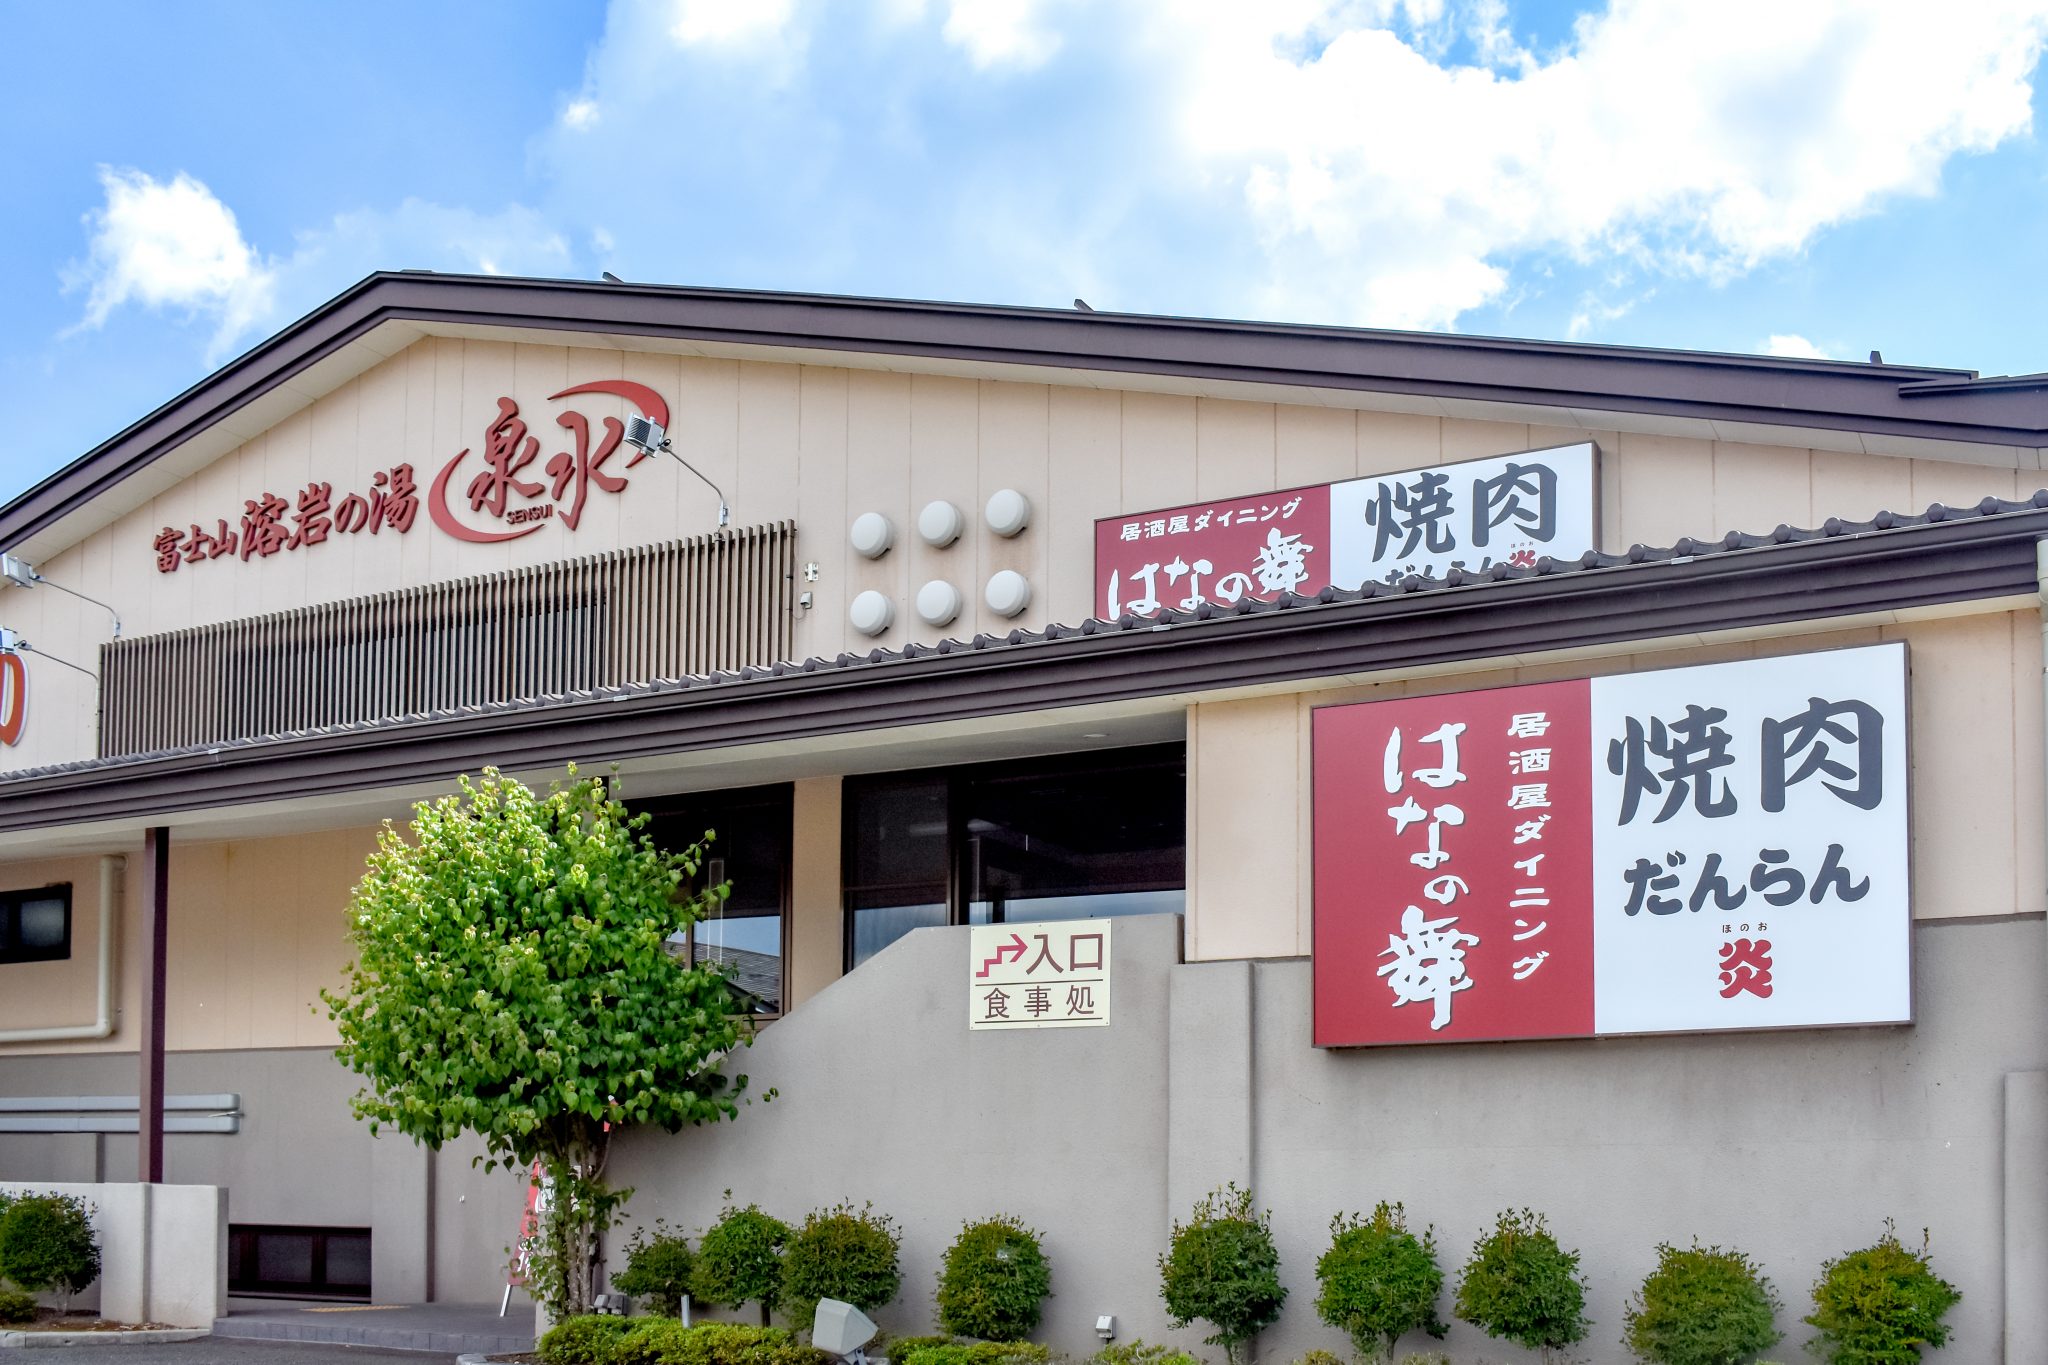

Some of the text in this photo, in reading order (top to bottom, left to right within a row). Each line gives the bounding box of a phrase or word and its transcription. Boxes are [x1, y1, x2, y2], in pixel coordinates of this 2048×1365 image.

[467, 397, 628, 531] 泉水
[152, 463, 420, 574] 富士山溶岩の湯
[506, 504, 553, 524] SENSUI
[1120, 496, 1302, 541] 居酒屋ダイニング
[1365, 462, 1558, 562] 焼肉
[1108, 527, 1313, 621] はなの舞
[1608, 697, 1884, 825] 焼肉
[1377, 722, 1479, 1031] はなの舞
[1507, 712, 1551, 980] 居酒屋ダイニング
[1624, 843, 1870, 917] だんらん
[1025, 933, 1104, 976] 入口
[1719, 938, 1773, 999] 炎
[1722, 922, 1768, 934] ほのお
[983, 984, 1095, 1020] 食事処
